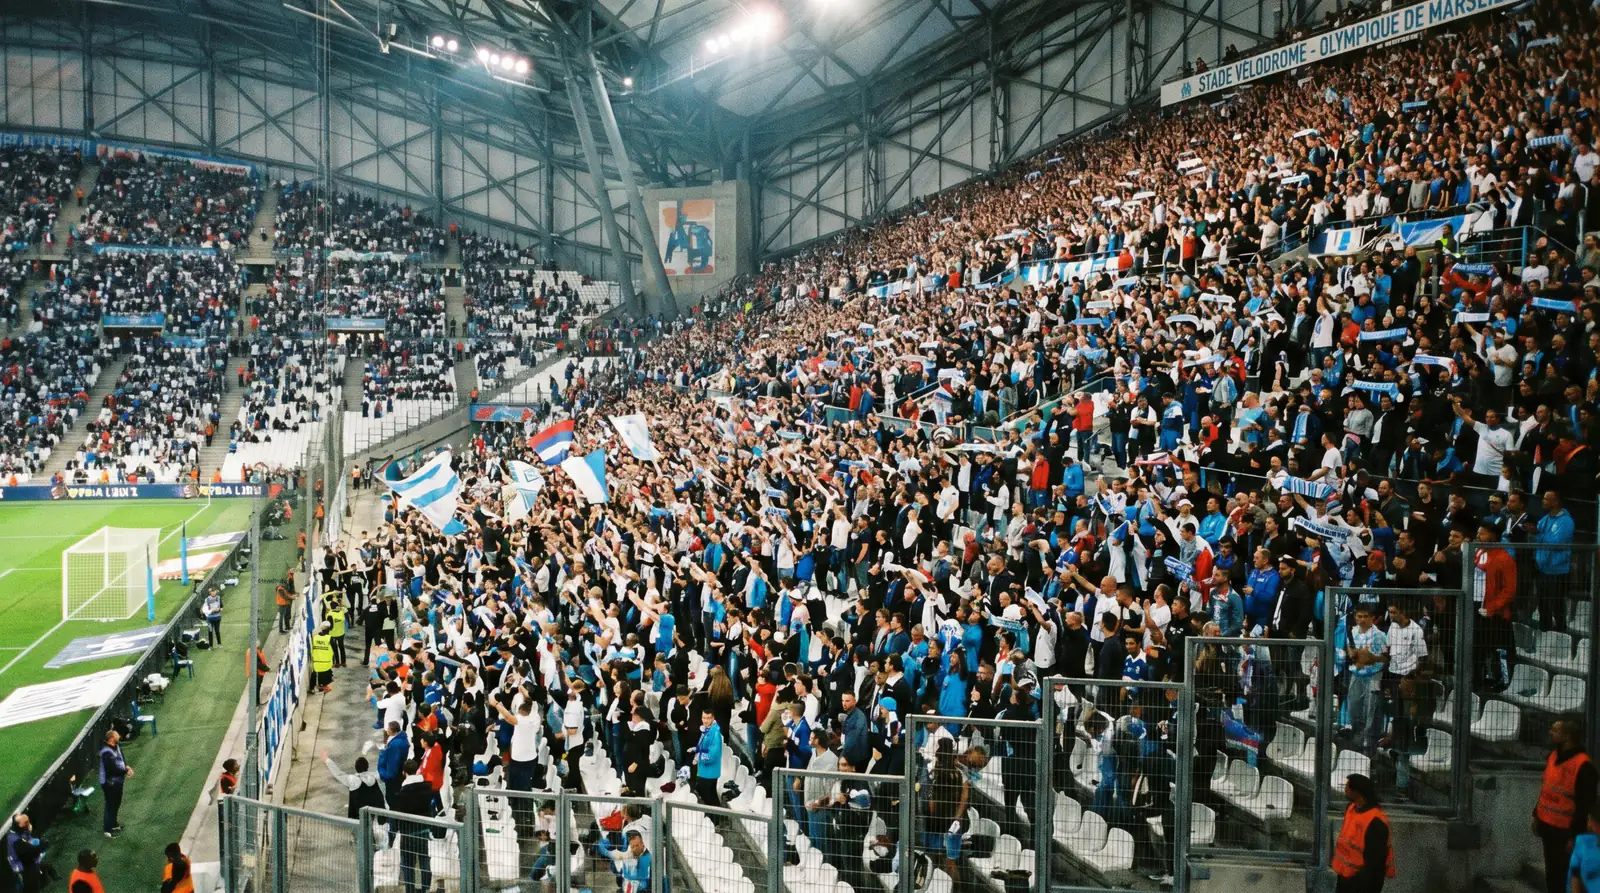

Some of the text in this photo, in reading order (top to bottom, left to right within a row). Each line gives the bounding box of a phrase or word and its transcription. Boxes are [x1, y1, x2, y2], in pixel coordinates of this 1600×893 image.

[1199, 66, 1233, 92] STADE
[1320, 13, 1400, 56] OLYMPIQUE
[1404, 5, 1425, 31] DE
[1428, 0, 1504, 24] MARS
